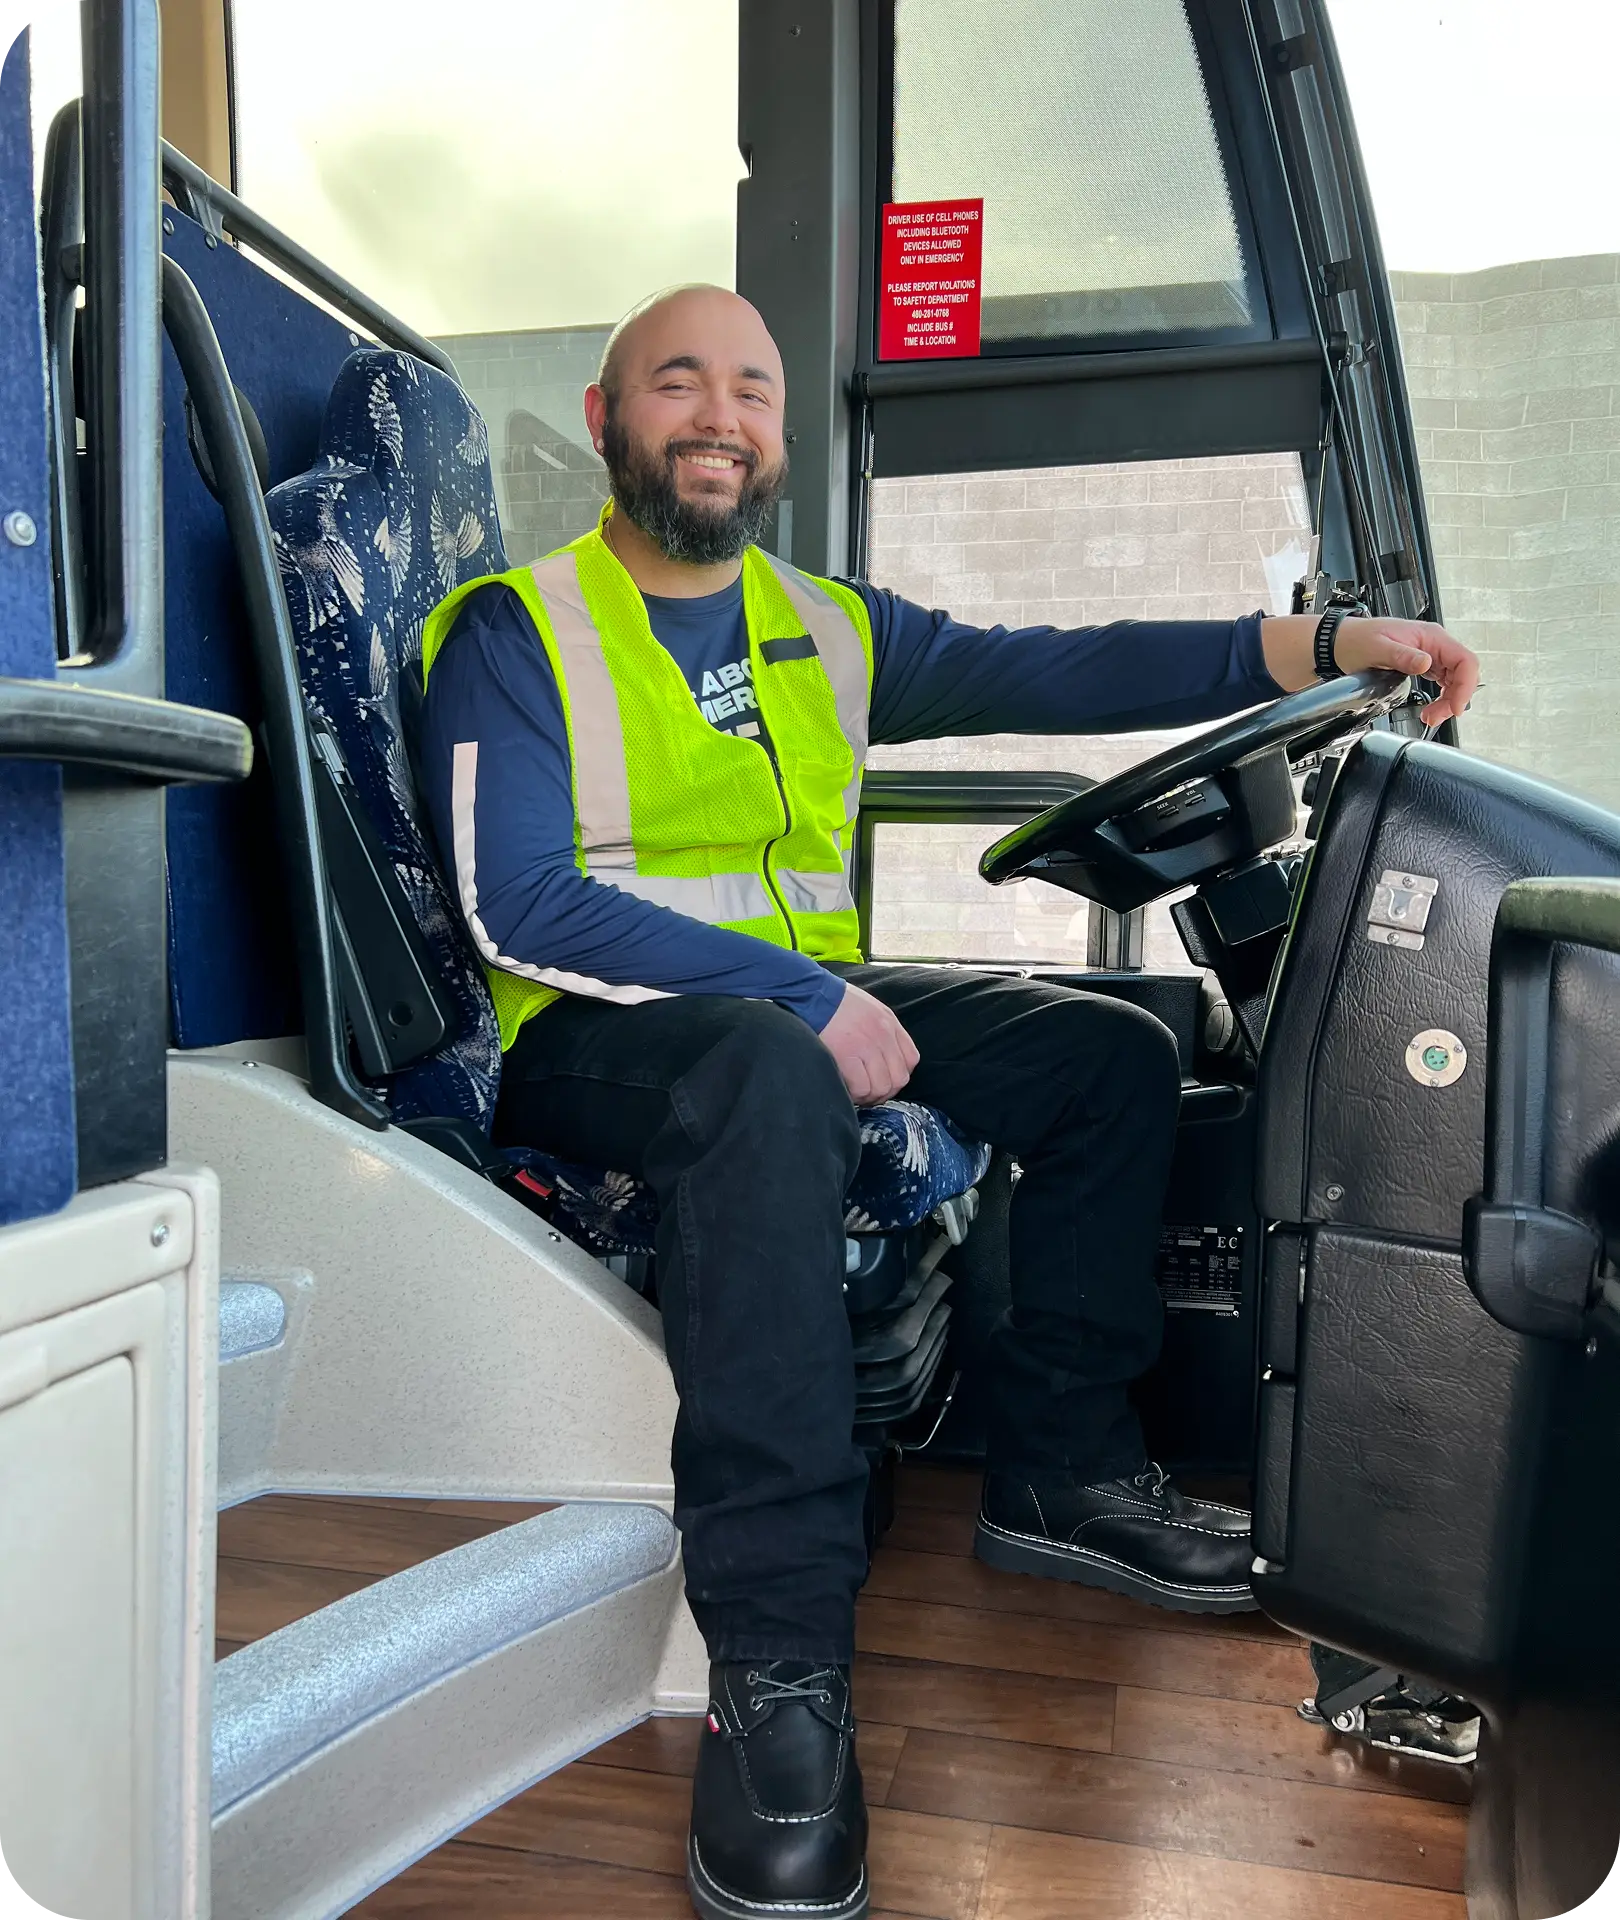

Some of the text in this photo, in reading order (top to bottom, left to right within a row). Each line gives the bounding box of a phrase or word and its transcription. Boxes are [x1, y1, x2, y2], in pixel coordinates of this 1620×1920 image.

[888, 211, 979, 225] DRIVER USE OF CELL PHONES
[897, 225, 969, 238] INCLUDING BLUETOOTH
[904, 239, 962, 251] DEVICES ALLOWED
[900, 253, 964, 265] ONLY IN EMERGENCY
[888, 280, 976, 293] PLEASE REPORT VIOLATIONS
[893, 294, 969, 306] TO SAFETY DEPARTMENT
[907, 321, 954, 333] INCLUDE BUS #
[904, 335, 956, 346] TIME & LOCATION
